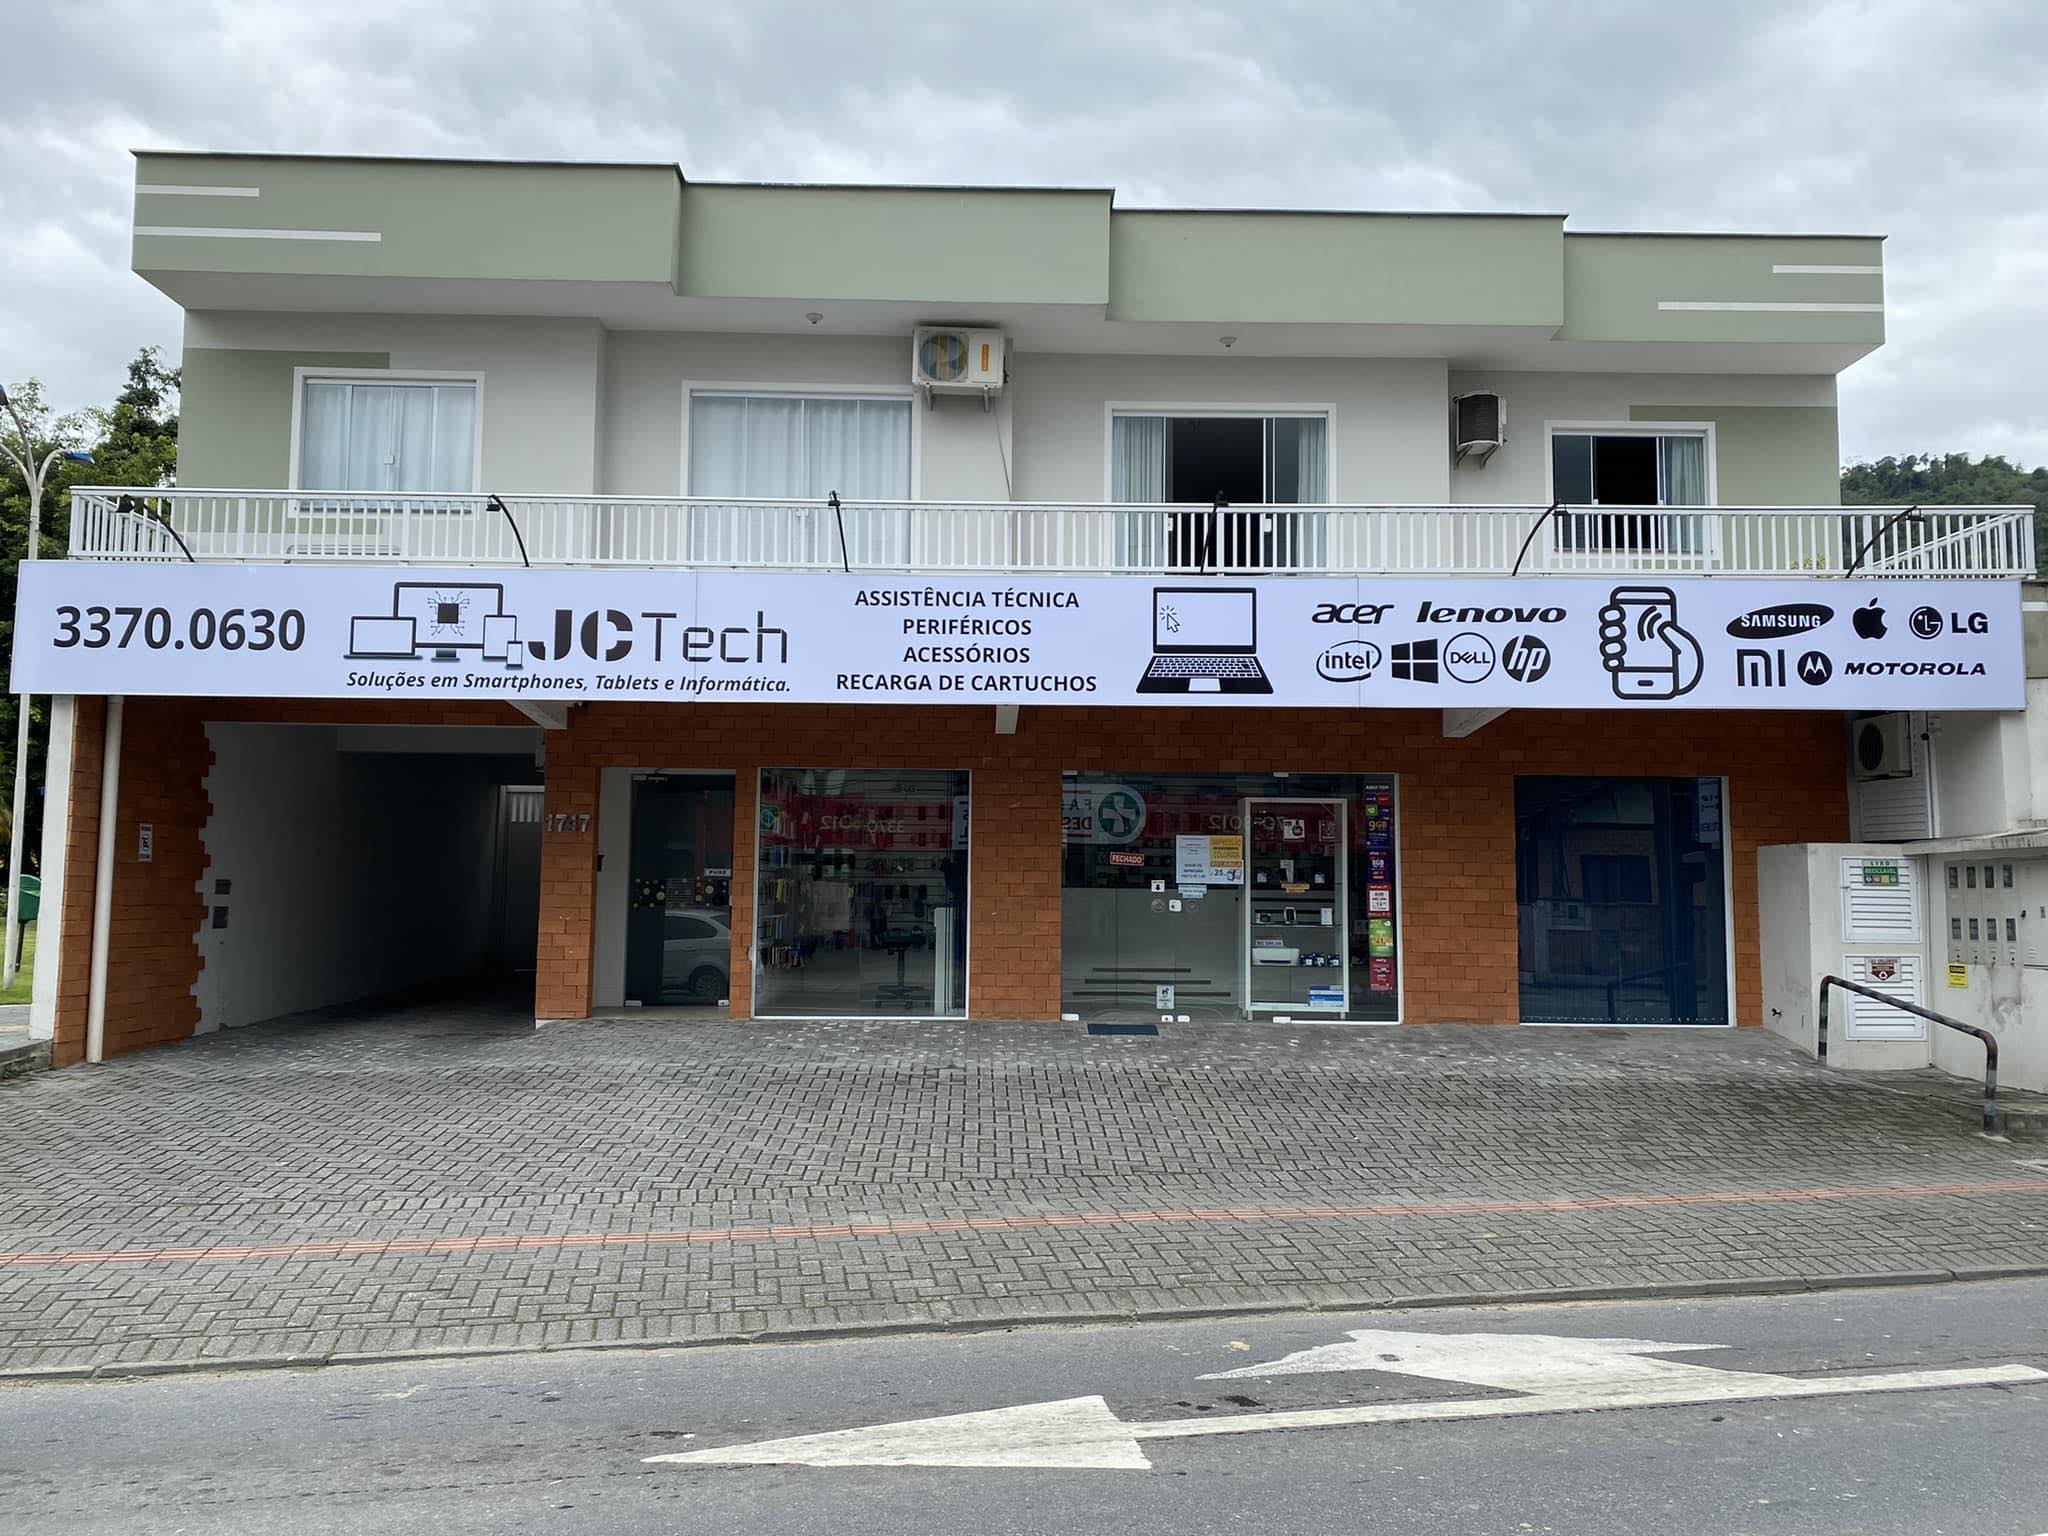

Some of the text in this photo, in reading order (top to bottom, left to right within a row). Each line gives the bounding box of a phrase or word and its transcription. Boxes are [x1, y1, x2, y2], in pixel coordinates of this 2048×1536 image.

[854, 587, 1080, 608] ASSISTÊNCIA TÉCNICA
[1311, 600, 1567, 625] acer lenovo
[1740, 613, 1822, 629] SAMSUNG
[1950, 612, 1989, 634] LG
[53, 605, 306, 652] 3370.0630
[903, 614, 1032, 636] PERIFÉRICOS
[903, 643, 1030, 664] ACESSÓRIOS
[1505, 635, 1549, 683] hp
[1844, 662, 1987, 676] MOTOROLA
[346, 671, 791, 695] Soluções em Smartphones, Tablets e Informática.
[836, 674, 1097, 692] RECARGA DE CARTUCHOS
[545, 813, 592, 833] 1747
[1111, 853, 1144, 865] FECHADO
